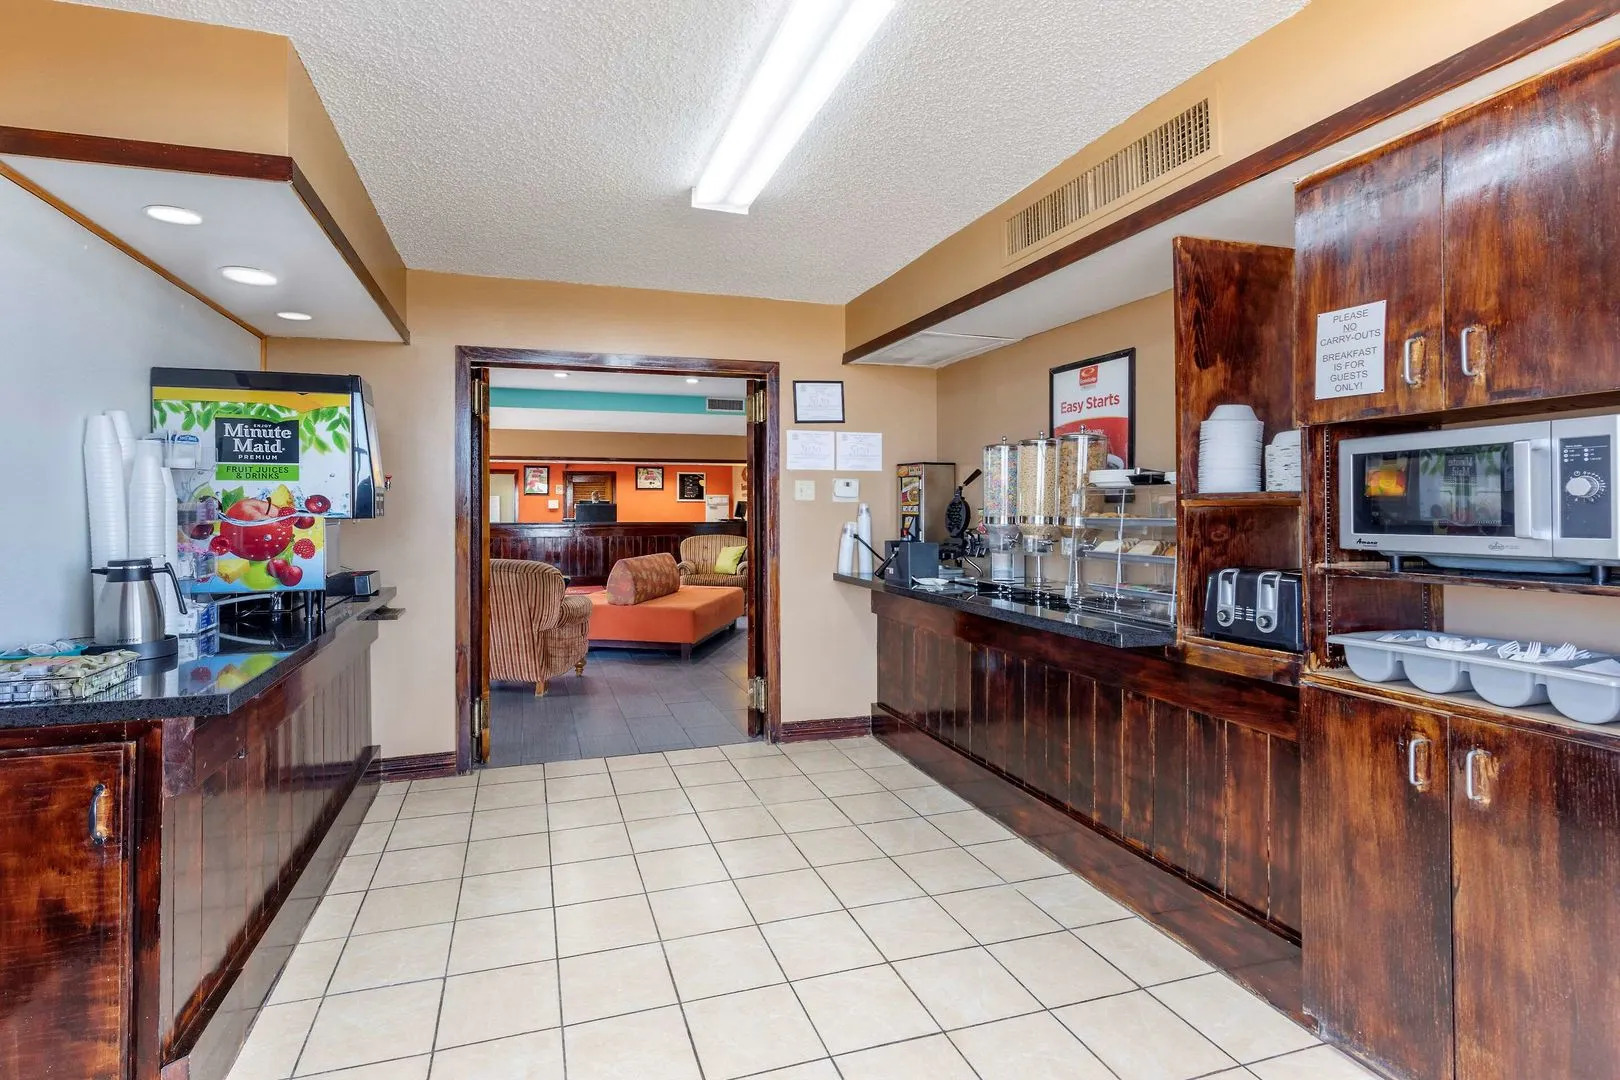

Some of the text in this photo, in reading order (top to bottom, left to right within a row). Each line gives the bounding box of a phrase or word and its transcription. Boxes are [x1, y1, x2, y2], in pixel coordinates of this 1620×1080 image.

[1333, 309, 1369, 323] PLEASE
[1343, 323, 1358, 332] NO
[1320, 329, 1381, 346] CARRY-OUTS
[1322, 346, 1377, 363] BREAKFAST
[1333, 360, 1365, 371] IS FOR
[1330, 370, 1368, 382] GUESTS
[1334, 382, 1363, 392] ONLY!
[1060, 394, 1120, 414] Easy Starts
[223, 422, 292, 439] Minute
[232, 438, 283, 453] Maid
[226, 465, 289, 474] FRUIT JUICES
[245, 472, 279, 480] DRINKS
